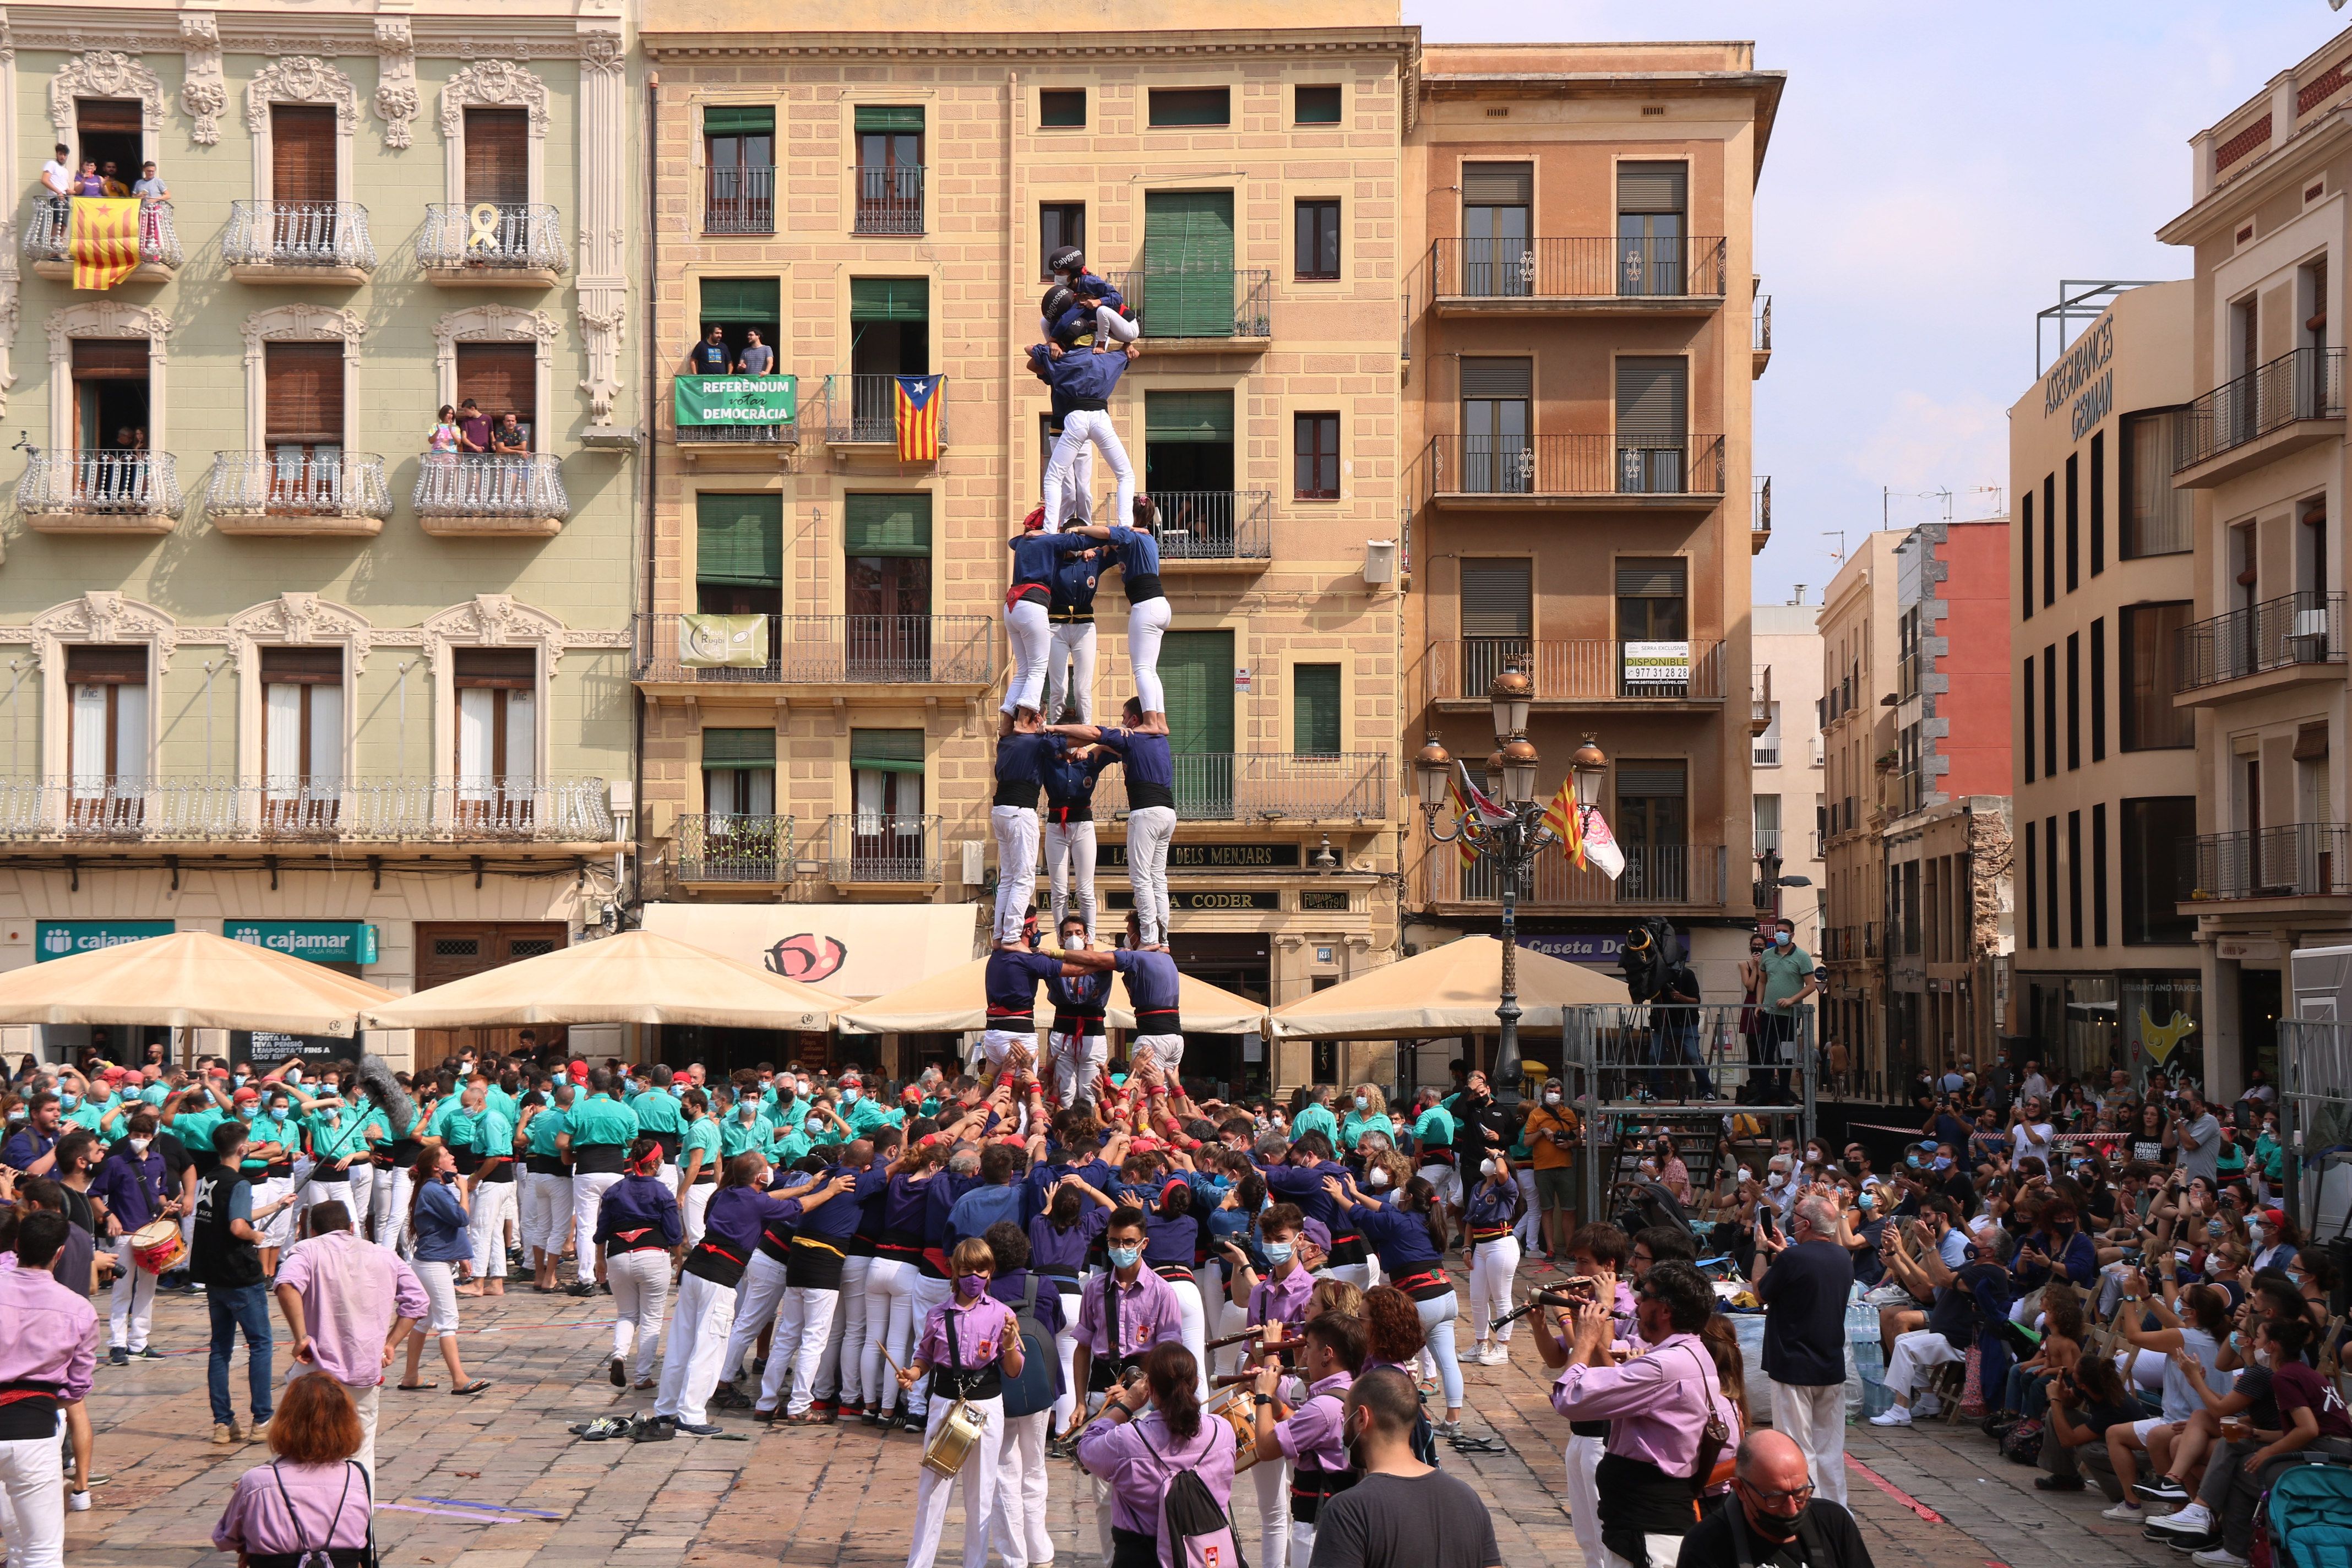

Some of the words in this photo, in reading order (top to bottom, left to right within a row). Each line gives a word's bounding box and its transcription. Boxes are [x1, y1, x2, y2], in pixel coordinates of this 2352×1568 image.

[2045, 313, 2113, 418] ASSEGURANCES
[703, 379, 788, 392] REFERÈNDUM
[729, 393, 767, 405] votar
[2072, 368, 2112, 442] GERMAN
[703, 406, 788, 420] DEMOCRÀCIA
[703, 626, 723, 635] Reus
[701, 634, 725, 645] Rugbi
[702, 643, 720, 652] Club
[1636, 668, 1650, 677] 977
[1653, 668, 1662, 677] 31
[1665, 668, 1675, 677] 28
[1678, 668, 1687, 677] 28
[1177, 848, 1204, 864] DELS
[1211, 848, 1272, 865] MENJARS
[1192, 894, 1253, 907] CODER
[1325, 895, 1345, 908] 1790
[266, 930, 350, 952] cajamar
[1527, 940, 1593, 954] Caseta
